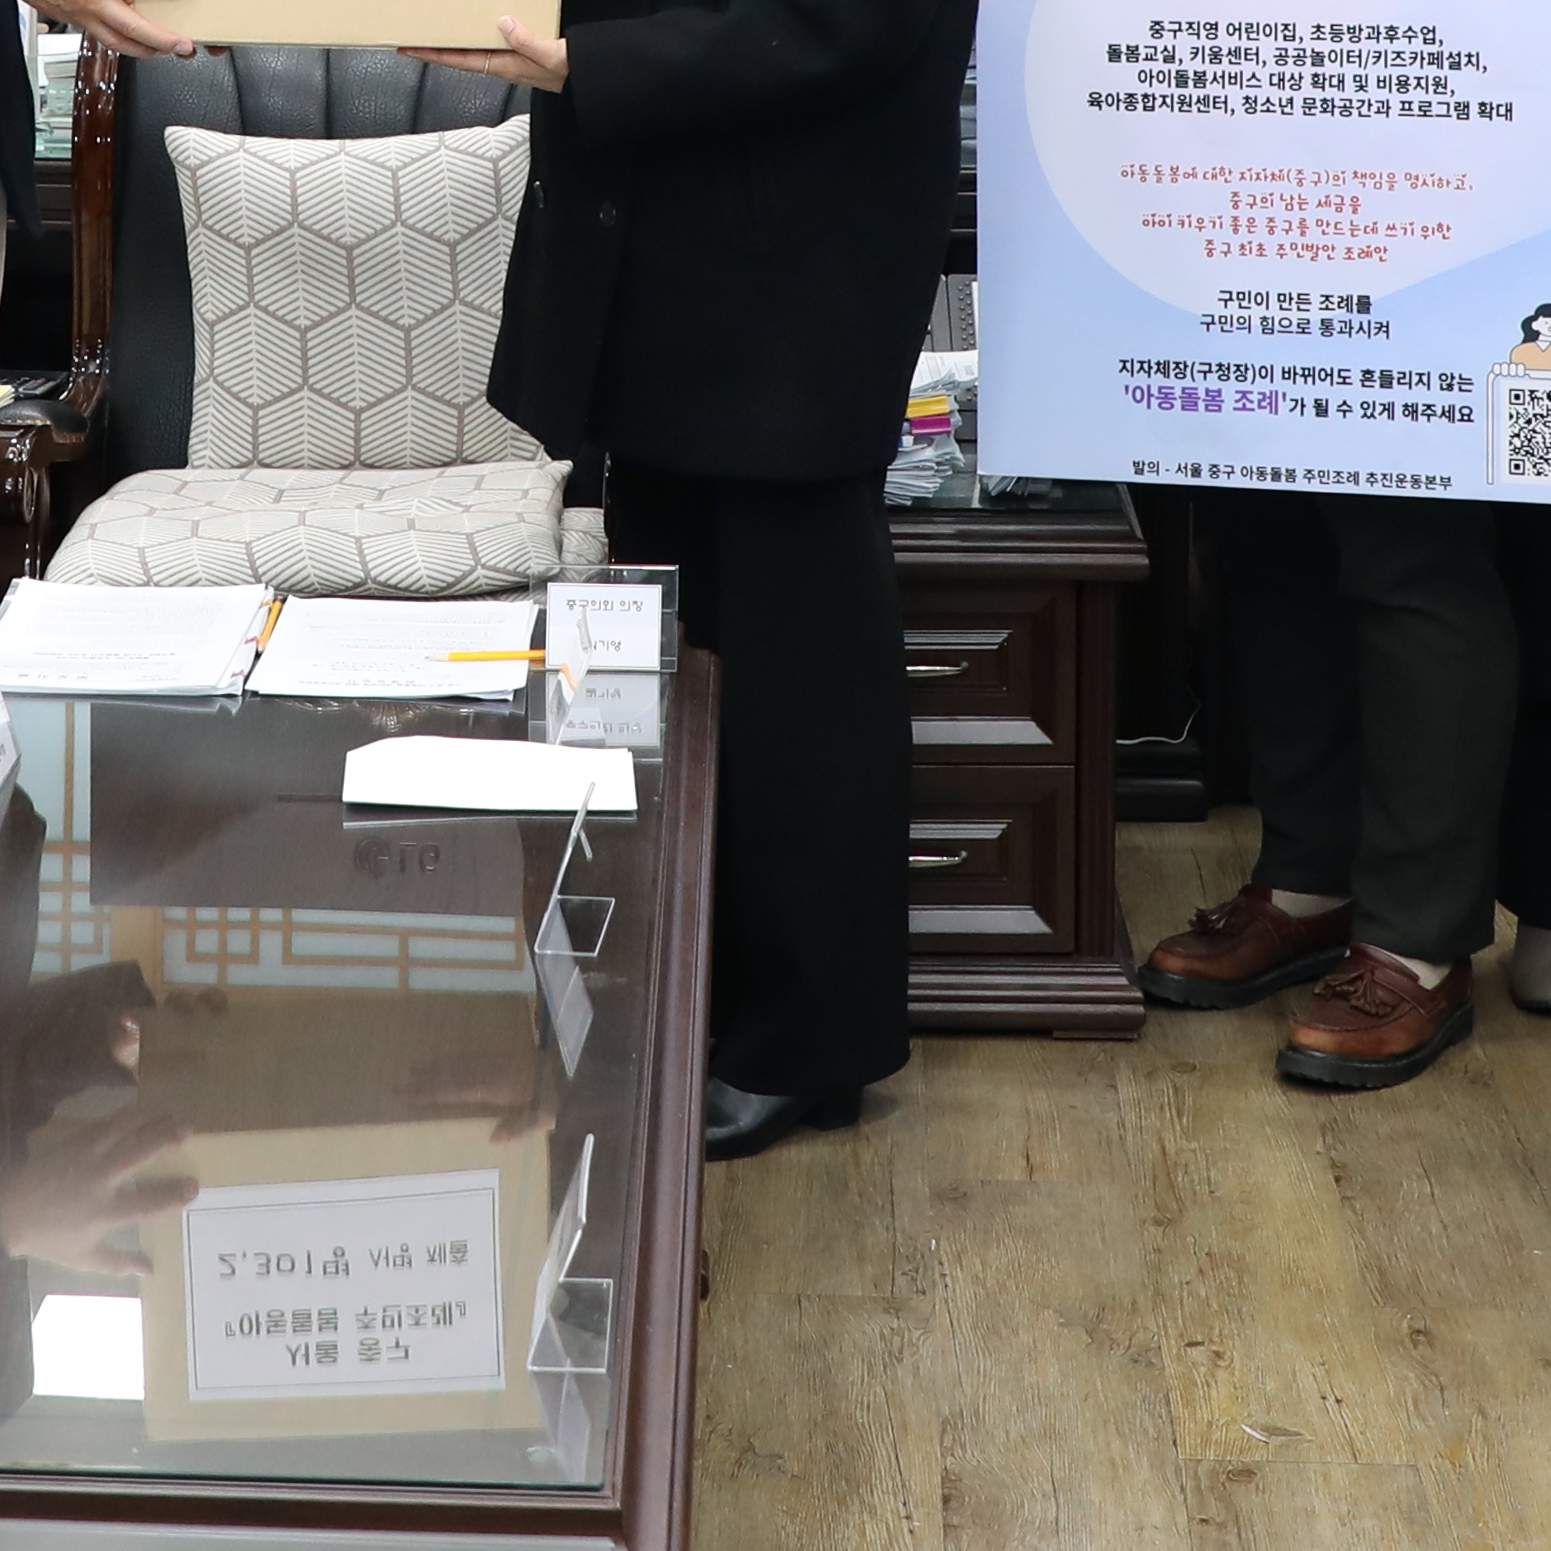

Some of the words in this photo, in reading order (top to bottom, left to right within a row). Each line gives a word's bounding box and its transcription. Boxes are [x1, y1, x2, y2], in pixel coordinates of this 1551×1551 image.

[1149, 21, 1218, 40] 중구직영
[1226, 22, 1303, 44] 어린이집,
[1310, 24, 1443, 47] 초등방과후수업,
[1107, 44, 1183, 66] 돌봄교실,
[1190, 45, 1266, 67] 키움센터,
[1274, 48, 1487, 73] 공공놀이터/키즈카페설치,
[1138, 69, 1262, 90] 아이돌봄서비스
[1269, 72, 1303, 91] 대상
[1311, 72, 1344, 92] 확대
[1353, 74, 1368, 93] 및
[1377, 74, 1455, 97] 비용지원,
[1087, 92, 1234, 116] 육아종합지원센터,
[1242, 95, 1293, 115] 청소년
[1301, 98, 1391, 118] 문화공간과
[1398, 101, 1469, 120] 프로그램
[1478, 102, 1512, 121] 확대
[1121, 164, 1197, 183] 아동돌봄에
[1203, 166, 1233, 183] 대한
[1239, 168, 1346, 187] 지자체(중구)의
[1352, 170, 1397, 191] 책임을
[1404, 173, 1472, 190] 명시하고,
[1230, 192, 1274, 210] 중구의
[1280, 193, 1309, 211] 남는
[1316, 195, 1361, 214] 세금을
[1142, 213, 1172, 228] 아이
[1177, 214, 1223, 232] 키우기
[1230, 216, 1257, 234] 좋은
[1266, 217, 1309, 237] 중구를
[1316, 219, 1378, 237] 만드는데
[1385, 222, 1414, 237] 쓰기
[1421, 222, 1452, 240] 위한
[1204, 239, 1232, 257] 중구
[1239, 241, 1267, 257] 최초
[1276, 243, 1336, 261] 주민발안
[1343, 245, 1388, 262] 조례안
[1218, 290, 1269, 310] 구민이
[1277, 292, 1312, 312] 만든
[1319, 295, 1372, 314] 조례를
[1200, 314, 1251, 334] 구민의
[1260, 316, 1312, 335] 힘으로
[1319, 318, 1389, 339] 통과시켜
[1119, 358, 1273, 384] 지자체장(구청장)이
[1282, 366, 1352, 386] 바뀌어도
[1360, 369, 1430, 390] 흔들리지
[1439, 373, 1474, 392] 않는
[1125, 384, 1224, 412] '아동돌봄
[1233, 390, 1306, 416] 조례'가
[1313, 399, 1328, 417] 될
[1336, 400, 1353, 418] 수
[1360, 401, 1394, 420] 있게
[1402, 403, 1474, 423] 해주세요
[1133, 461, 1159, 476] 발의
[1175, 462, 1202, 478] 서울
[1208, 464, 1235, 479] 중구
[1241, 466, 1297, 483] 아동돌봄
[1303, 469, 1359, 486] 주민조례
[1366, 472, 1452, 490] 추진운동본부
[566, 599, 614, 612] 중구의회
[619, 600, 644, 612] 의장
[592, 640, 622, 652] 기영
